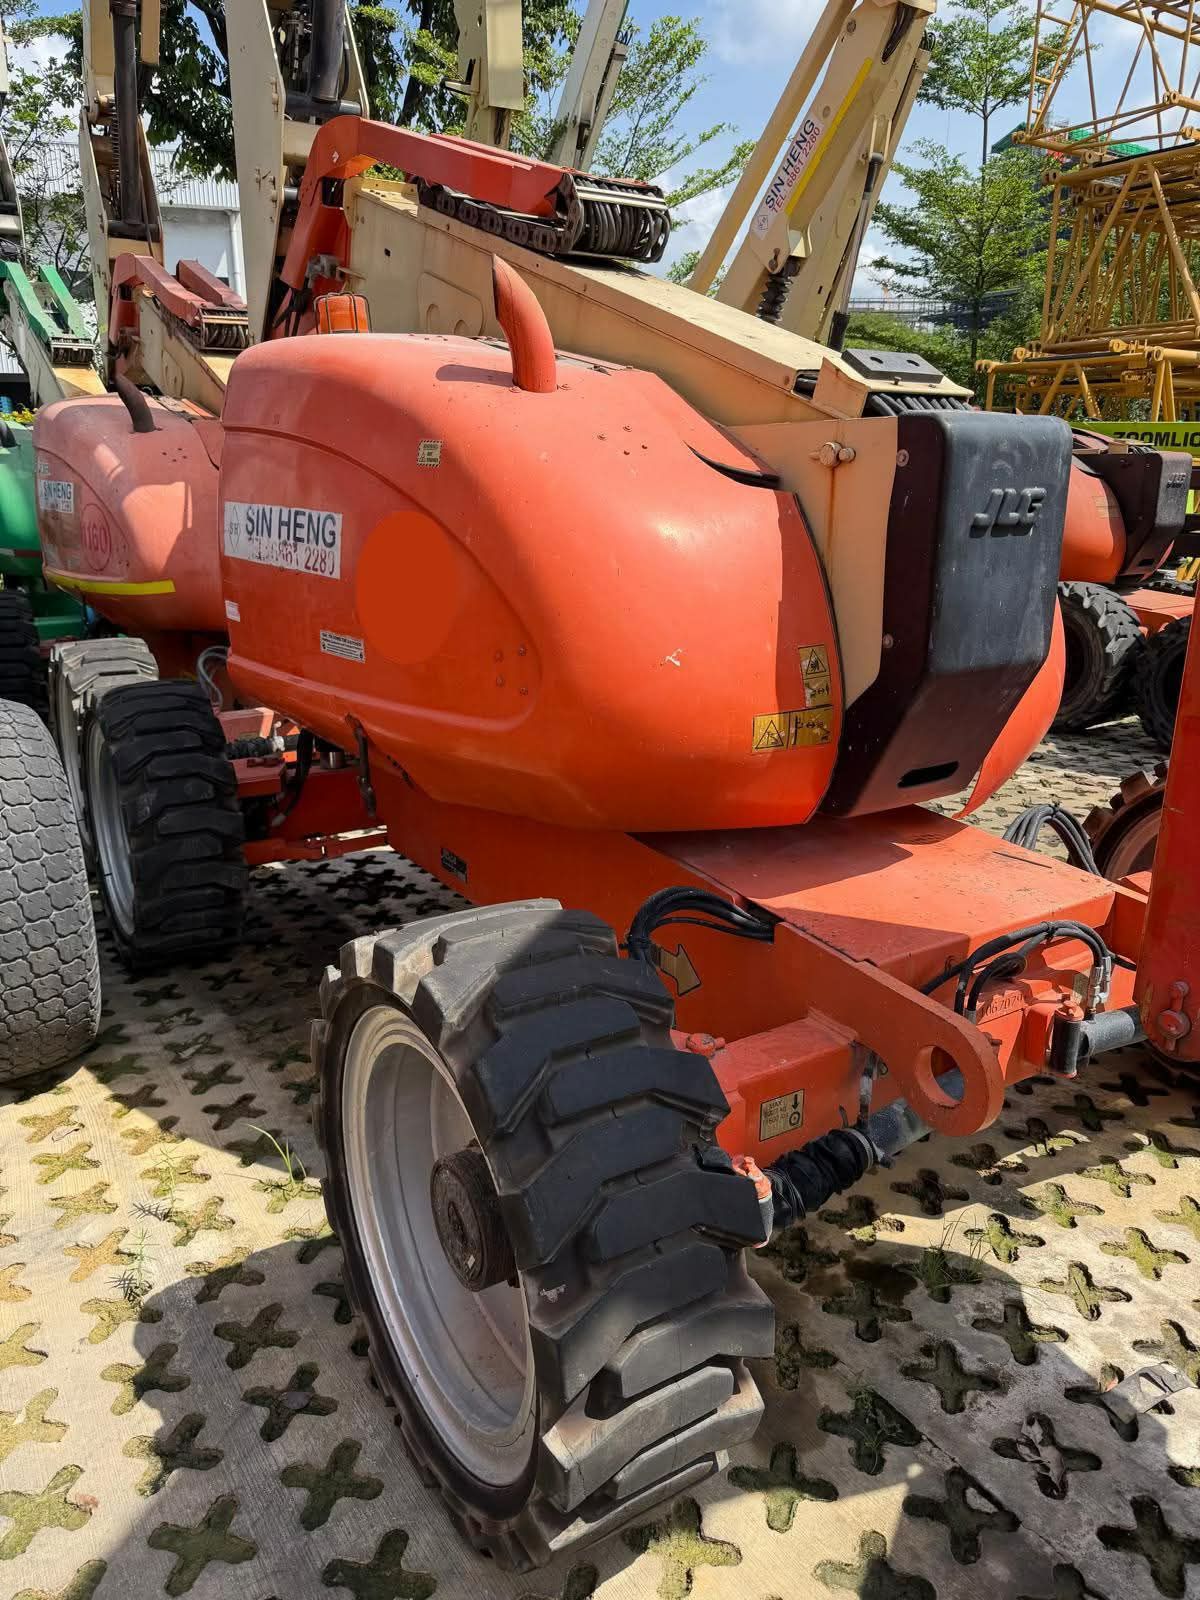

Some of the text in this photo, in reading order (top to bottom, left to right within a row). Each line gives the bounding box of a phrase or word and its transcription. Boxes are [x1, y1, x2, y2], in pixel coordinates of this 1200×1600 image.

[765, 119, 815, 209] SIN HENG
[786, 158, 804, 188] 6861
[802, 126, 821, 158] 2280
[245, 506, 336, 549] SIN HENG
[970, 486, 1047, 535] JLG
